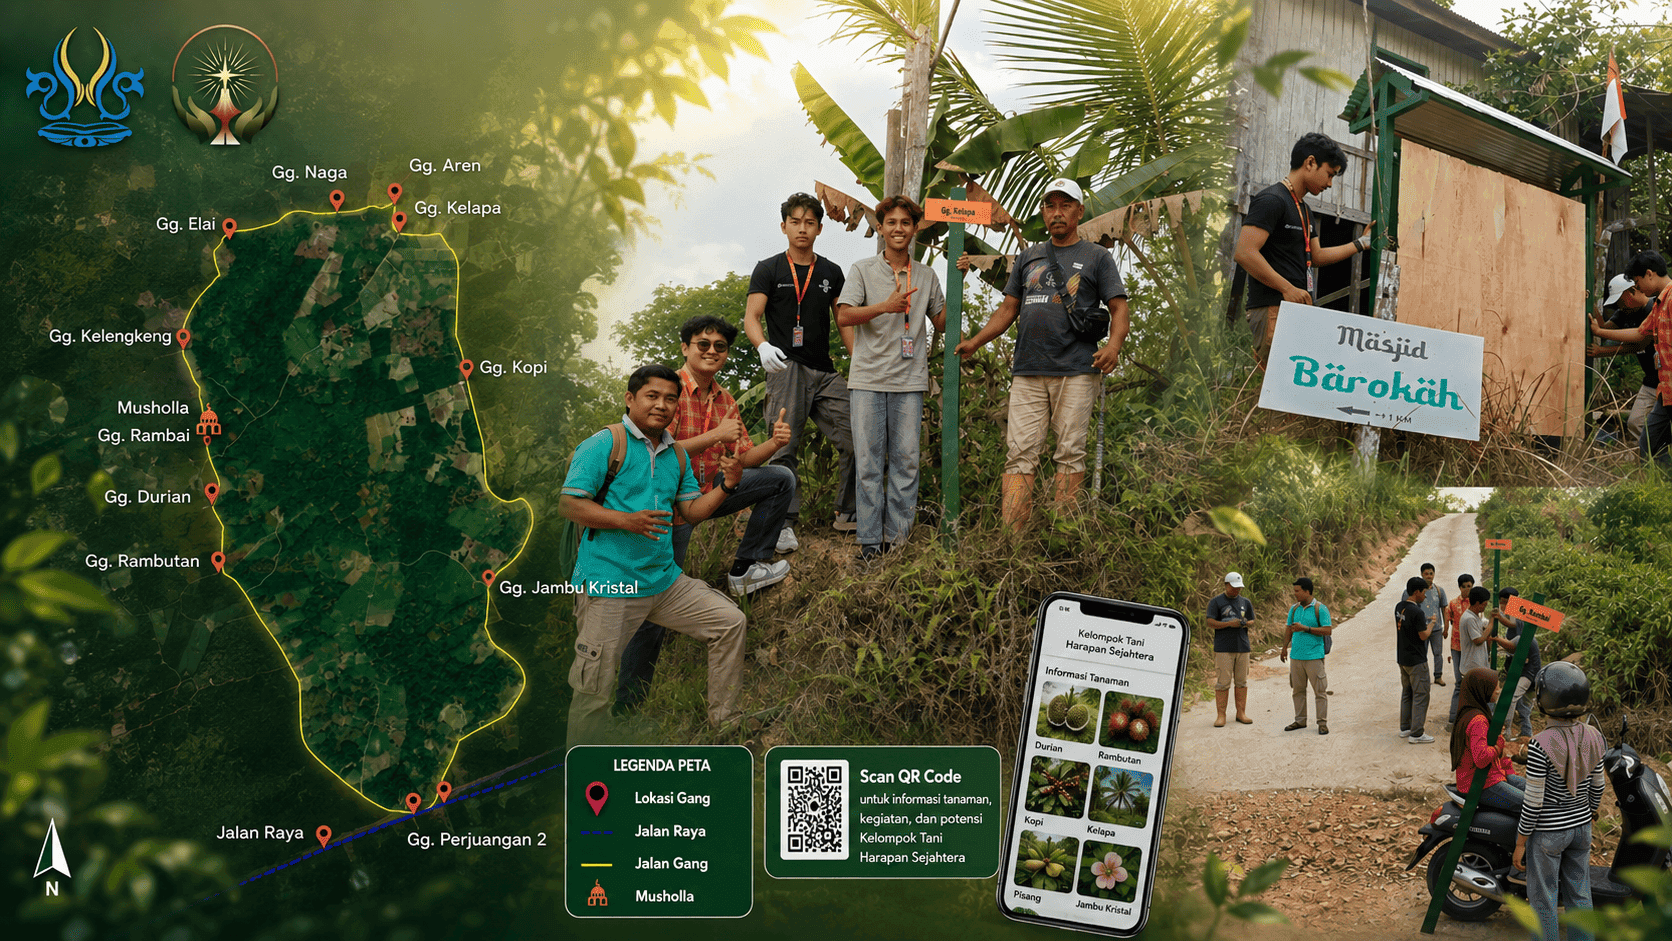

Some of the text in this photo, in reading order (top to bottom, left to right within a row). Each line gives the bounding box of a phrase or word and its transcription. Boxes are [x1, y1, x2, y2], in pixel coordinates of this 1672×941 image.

[1078, 629, 1145, 647] Kelompok Tani
[1065, 640, 1154, 662] Harapan Sejahtera
[1045, 666, 1130, 687] Informasi Tanaman
[1035, 741, 1063, 753] Durian
[1098, 751, 1142, 765] Rambutan
[1024, 816, 1044, 827] Kopi
[1087, 825, 1116, 838] Kelapa
[1013, 890, 1042, 904] Pisang
[1075, 900, 1132, 916] Jambu Kristal
